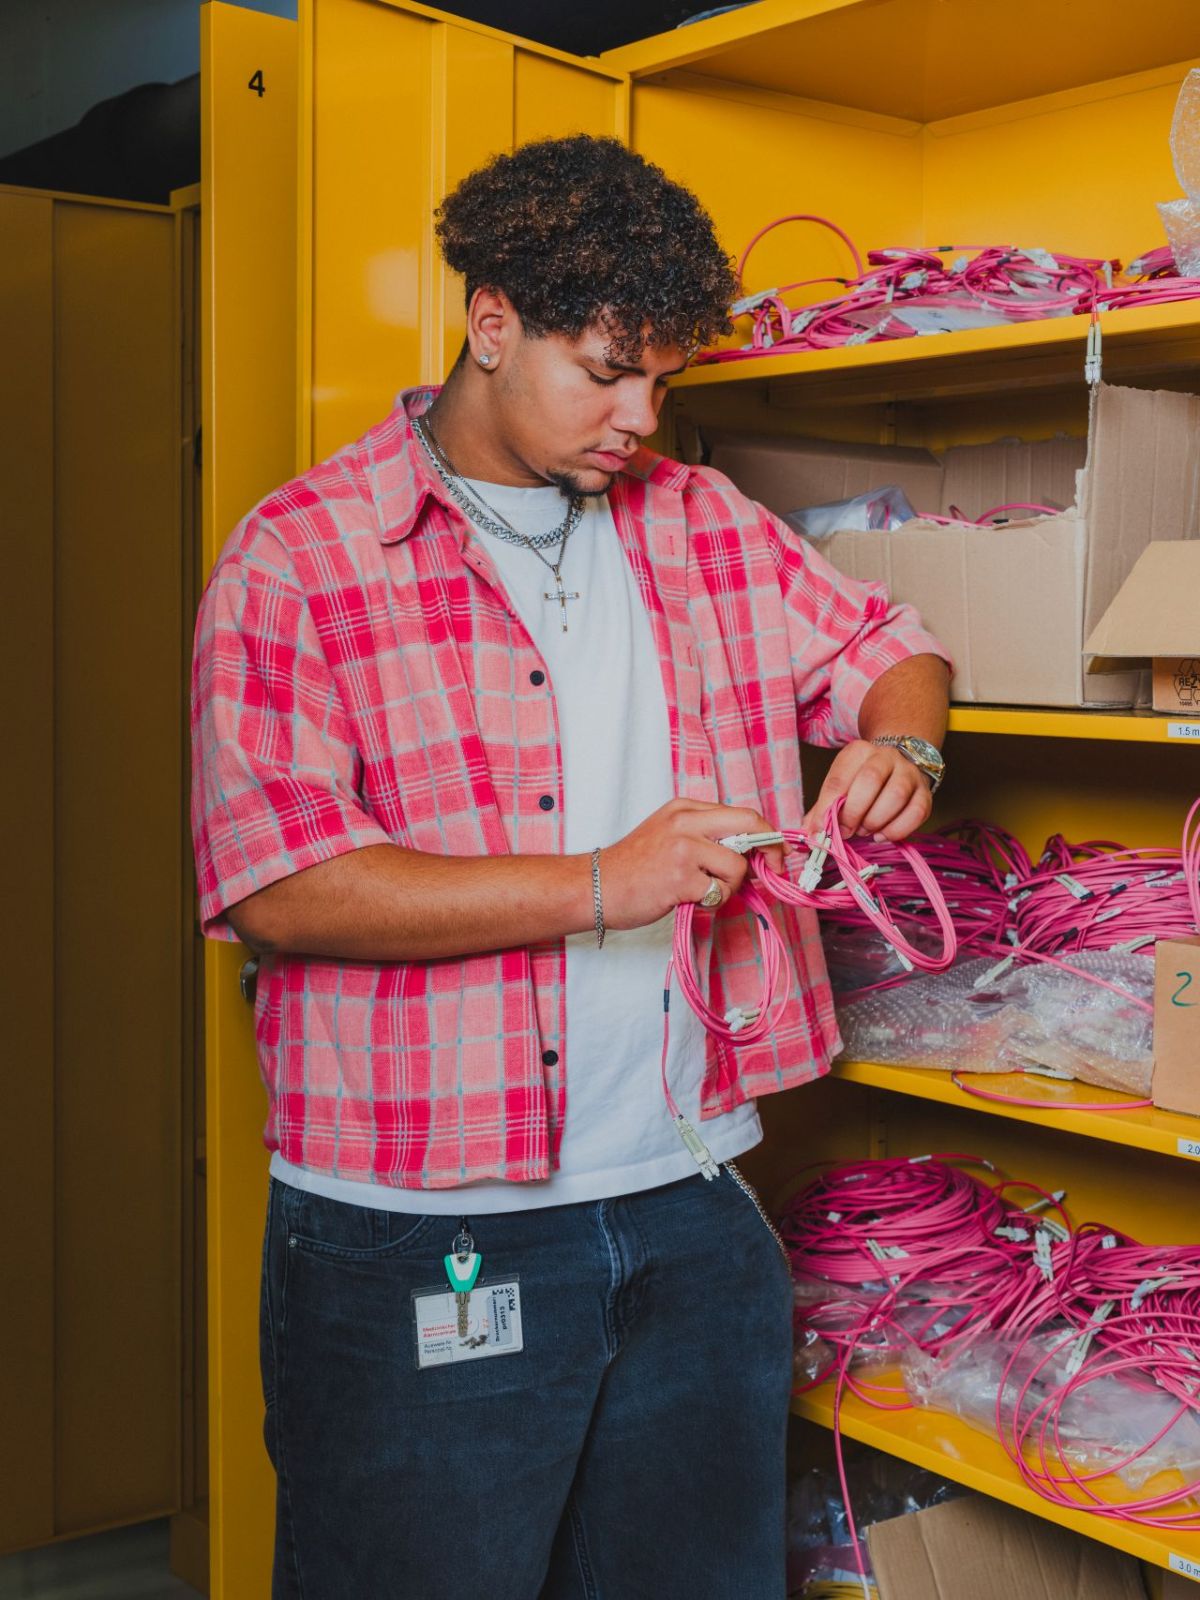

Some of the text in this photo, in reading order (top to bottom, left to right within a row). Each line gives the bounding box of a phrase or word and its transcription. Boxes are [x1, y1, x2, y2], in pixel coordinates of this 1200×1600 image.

[248, 70, 265, 97] 4
[1171, 971, 1199, 1007] 2
[1179, 1560, 1192, 1573] 3.0
